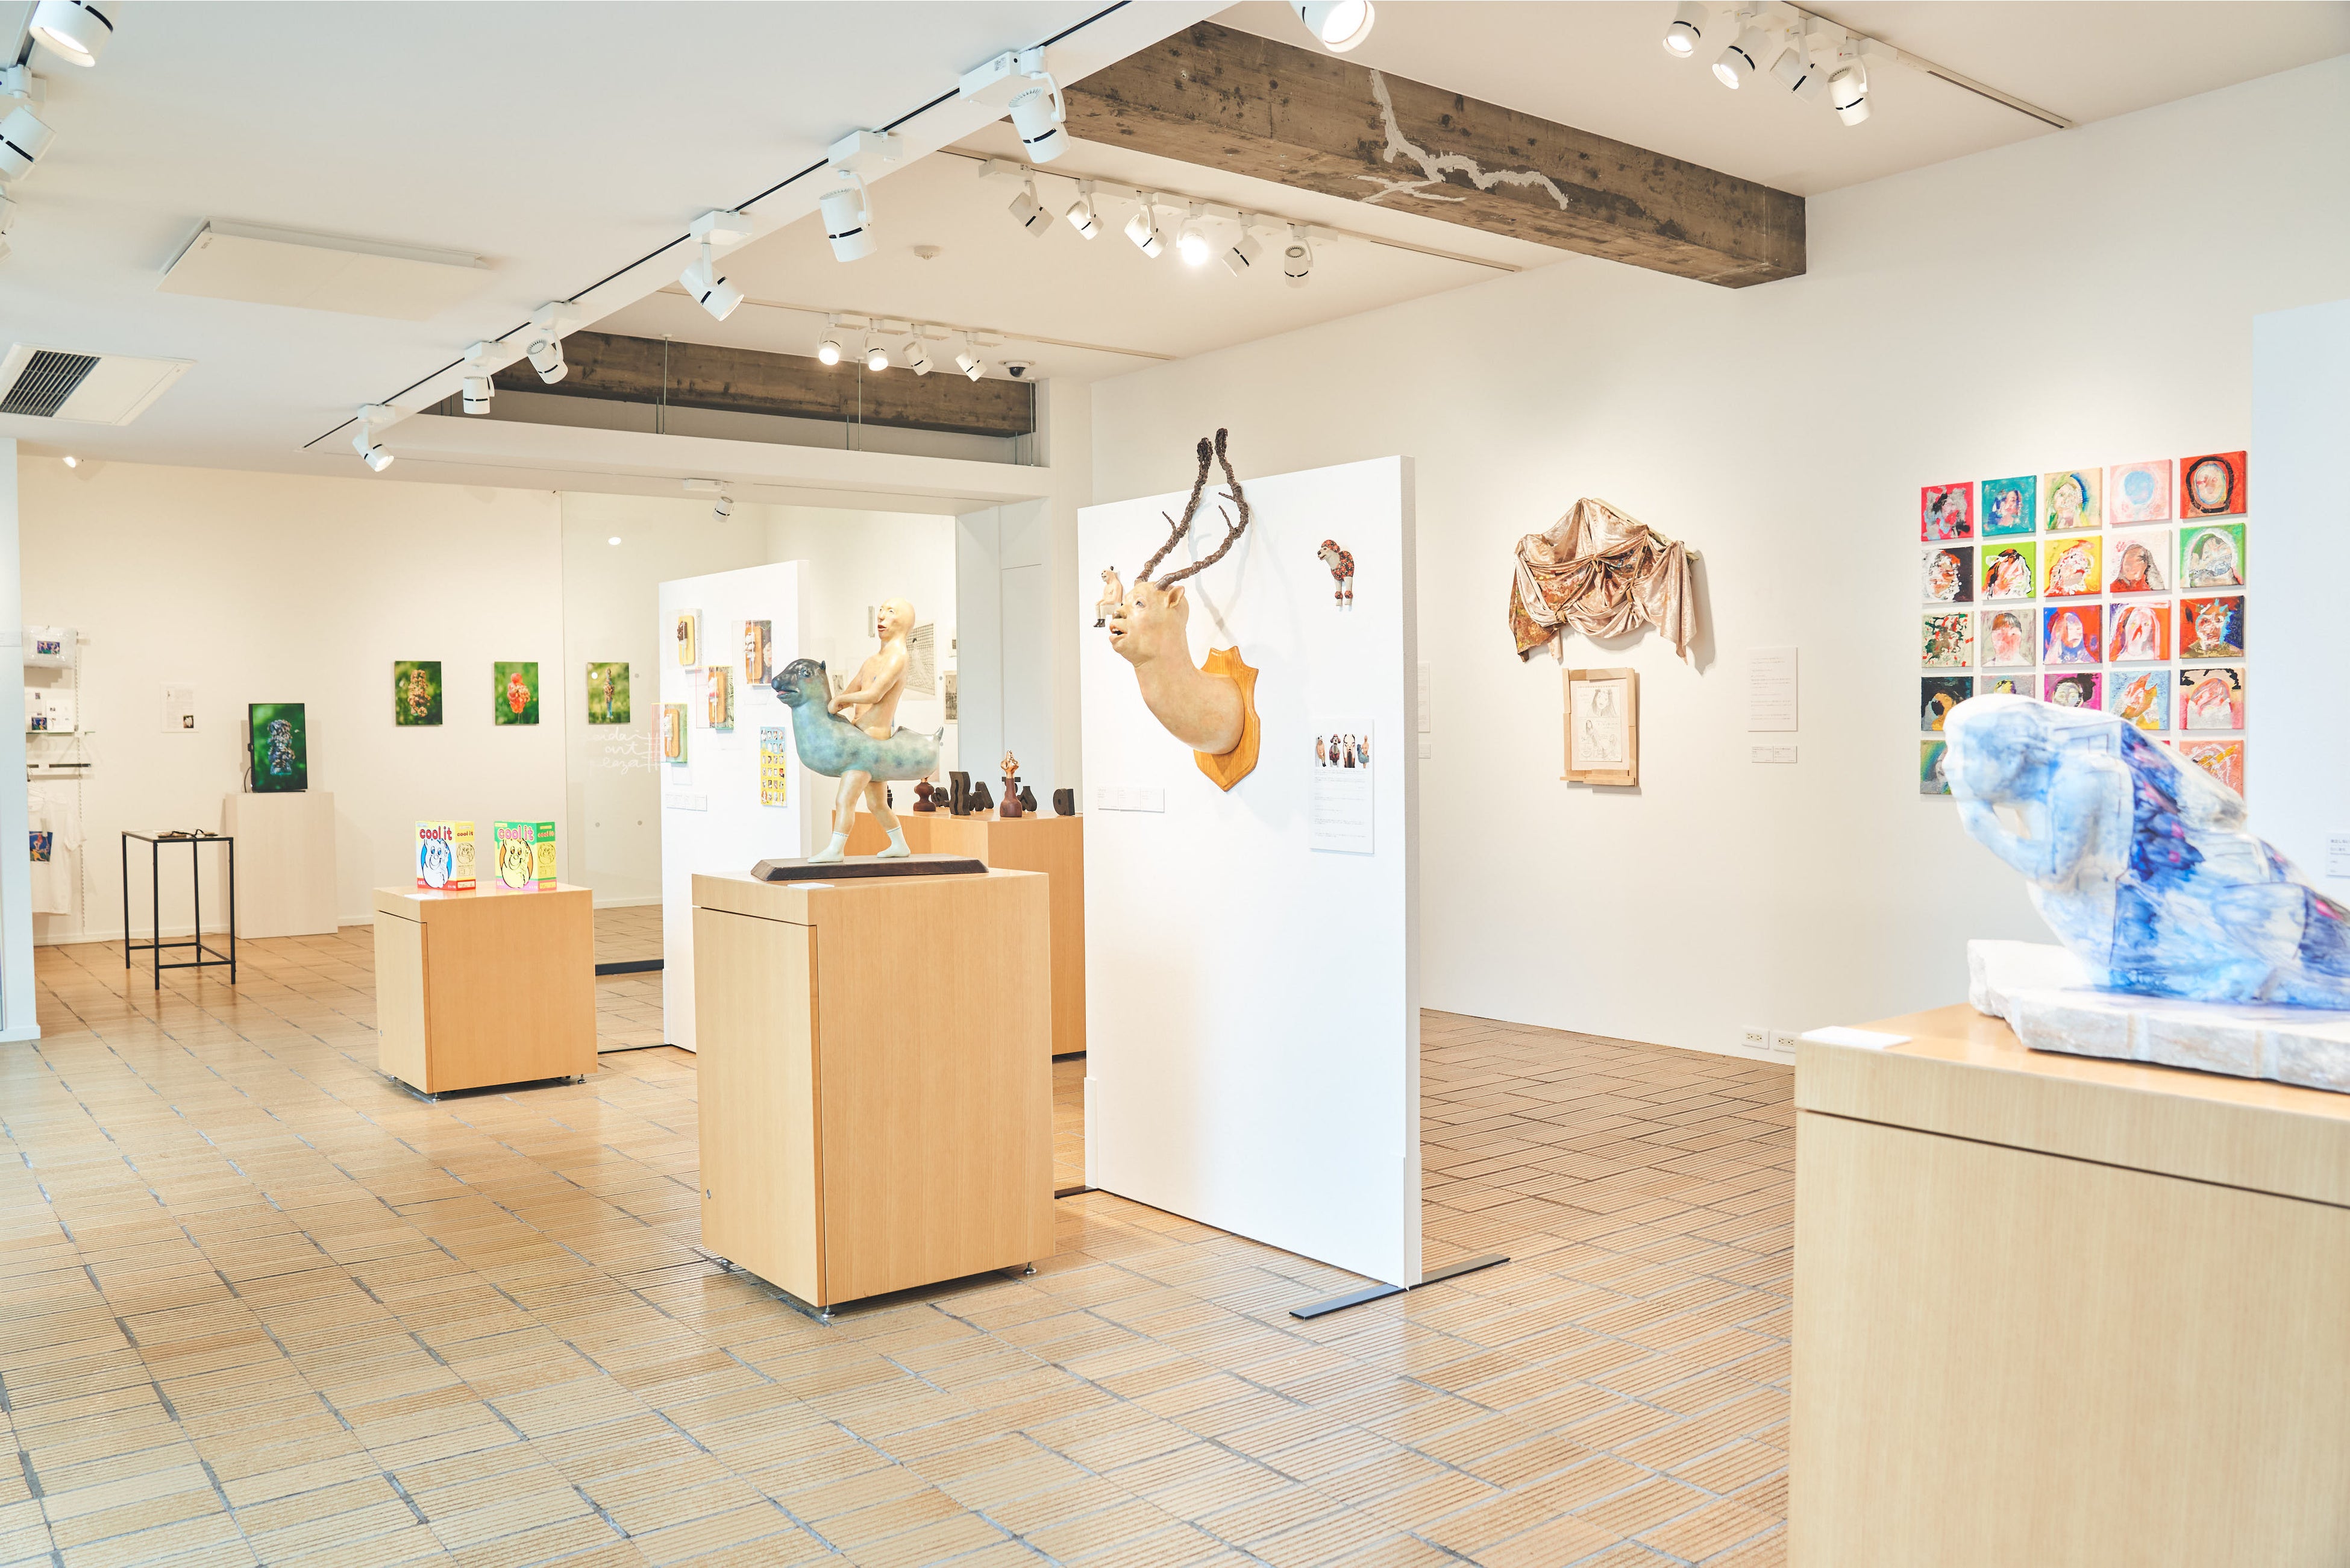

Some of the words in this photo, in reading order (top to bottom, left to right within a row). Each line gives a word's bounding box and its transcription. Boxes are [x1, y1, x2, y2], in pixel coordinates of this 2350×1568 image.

[419, 826, 441, 839] cool
[443, 826, 453, 841] it
[498, 825, 521, 840] cool
[524, 826, 534, 841] it
